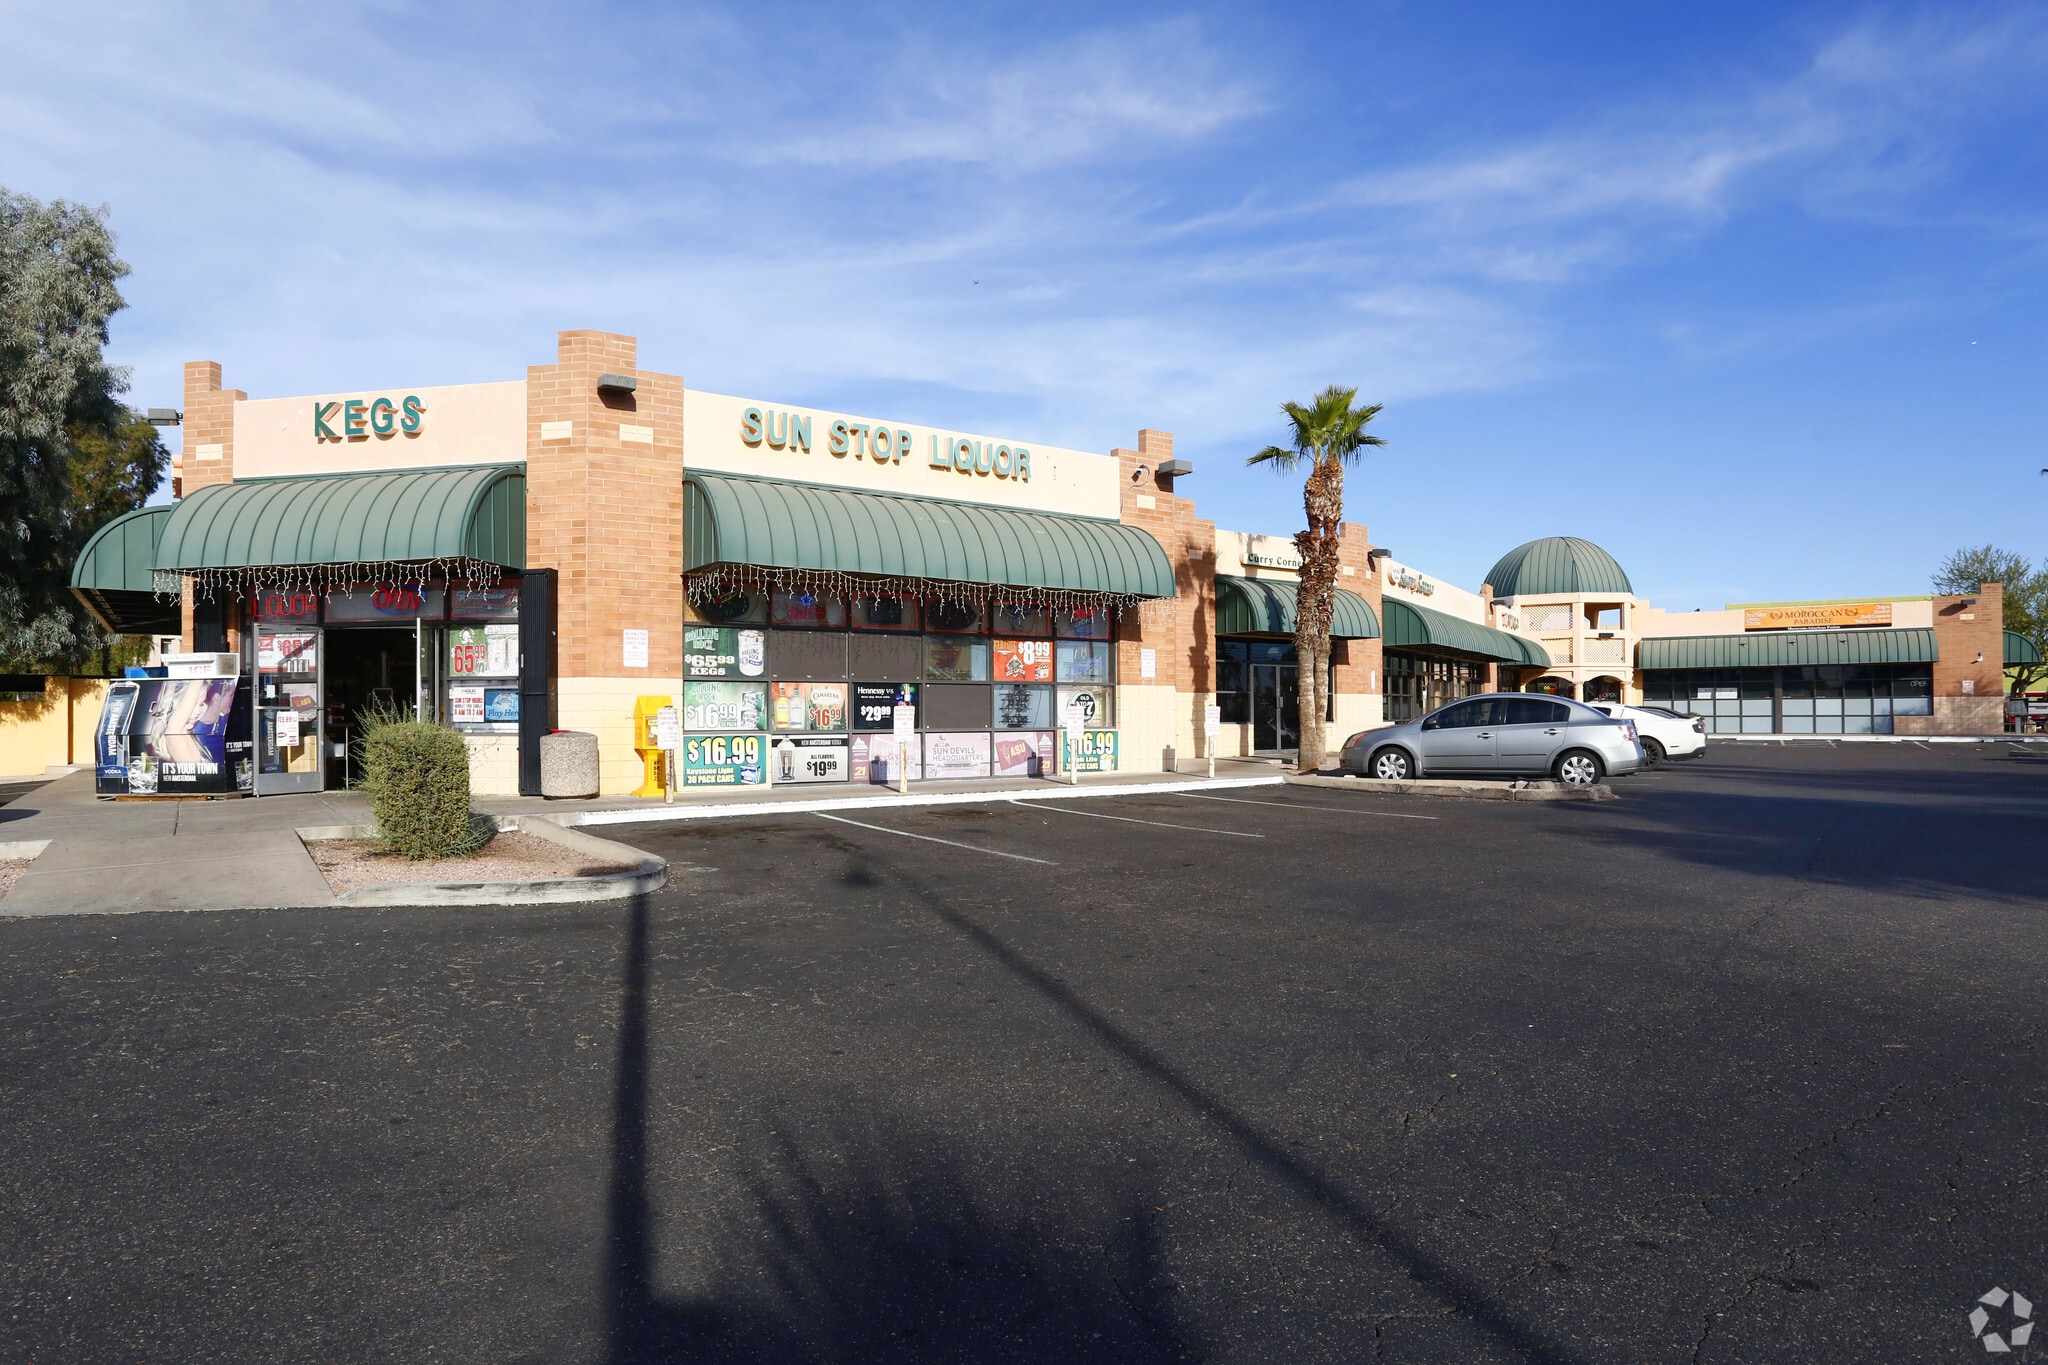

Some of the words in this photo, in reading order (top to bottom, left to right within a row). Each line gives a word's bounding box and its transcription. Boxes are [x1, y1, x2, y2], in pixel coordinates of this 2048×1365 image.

[314, 395, 427, 441] KEGS
[741, 407, 812, 451] SUN
[828, 419, 912, 464] STOP
[929, 434, 1032, 482] LIQUOR
[1248, 553, 1273, 566] Curry
[1277, 556, 1303, 568] Corne
[373, 587, 421, 611] OPEN
[253, 594, 317, 617] LIQUOR
[1785, 609, 1844, 619] MOROCCAN
[685, 628, 719, 643] ROLLING
[693, 640, 716, 650] ROCK
[690, 667, 726, 676] KEGS
[812, 691, 840, 701] CAMARENA
[857, 686, 886, 696] Hennessy
[699, 692, 717, 702] ROCK
[488, 708, 504, 718] Play
[687, 736, 760, 766] $16.99
[932, 747, 949, 755] SUN
[950, 746, 976, 755] DEVILS
[1009, 743, 1026, 757] ASU
[932, 753, 984, 762] HEADQUARTERS
[162, 763, 177, 775] IT'S
[176, 763, 196, 775] YOUR
[196, 762, 218, 774] TOWN
[686, 767, 717, 776] Keystone
[717, 767, 735, 776] Light
[854, 766, 867, 776] 21
[687, 776, 698, 784] 30
[698, 775, 717, 784] PACK
[716, 774, 735, 783] CANS
